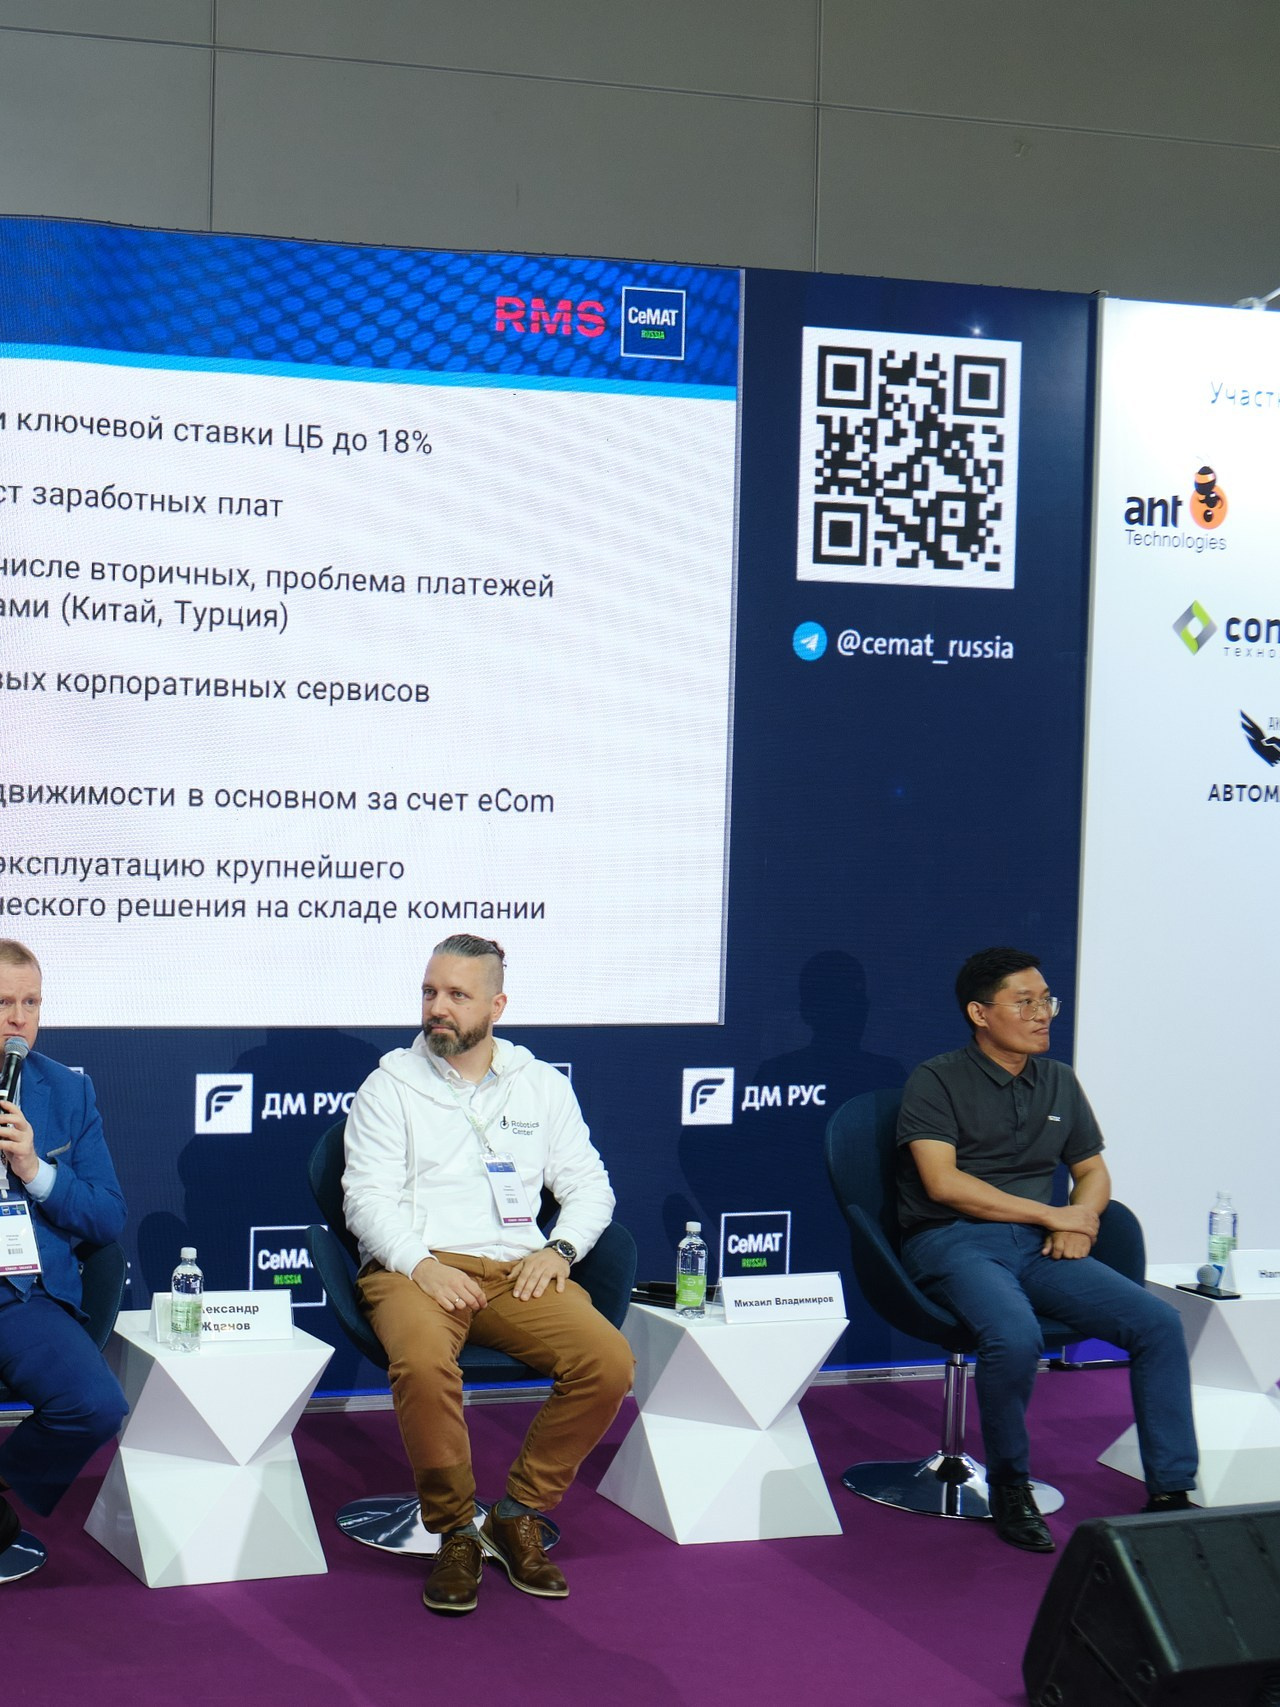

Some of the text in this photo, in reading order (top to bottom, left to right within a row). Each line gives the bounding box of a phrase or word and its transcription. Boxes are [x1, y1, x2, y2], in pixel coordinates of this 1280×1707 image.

[495, 296, 606, 338] RMS
[627, 306, 679, 327] CeMAT
[1210, 380, 1280, 409] Участ
[17, 412, 163, 441] ключевой
[173, 422, 273, 446] ставки
[284, 423, 324, 454] ЦБ
[332, 432, 368, 456] до
[377, 428, 433, 455] 18%
[32, 483, 207, 514] заработных
[218, 496, 284, 518] плат
[1124, 495, 1184, 528] ant
[1125, 528, 1227, 553] Technologies
[90, 561, 256, 592] вторичных,
[266, 565, 406, 595] проблема
[417, 573, 554, 598] платежей
[61, 592, 163, 628] (Китай,
[173, 599, 288, 635] Турция)
[837, 628, 1014, 665] @cemat_russia
[1223, 646, 1280, 659] техно
[56, 672, 286, 702] корпоративных
[296, 680, 430, 707] сервисов
[188, 787, 204, 807] в
[214, 788, 357, 810] основном
[367, 791, 398, 811] за
[406, 792, 469, 812] счет
[477, 787, 554, 813] eCom
[1207, 783, 1280, 803] АВТОМ
[216, 854, 405, 885] крупнейшего
[117, 897, 246, 924] решения
[257, 899, 289, 919] на
[297, 899, 398, 924] складе
[407, 900, 545, 920] компании
[261, 1092, 357, 1120] ДМ РУС
[741, 1084, 826, 1111] ДМ РУС
[511, 1120, 540, 1129] Robotics
[512, 1127, 534, 1136] Center
[727, 1232, 783, 1255] CeMAT
[257, 1248, 314, 1270] CeMA
[201, 1304, 260, 1315] ександр
[733, 1295, 835, 1308] Михаил Владимиров
